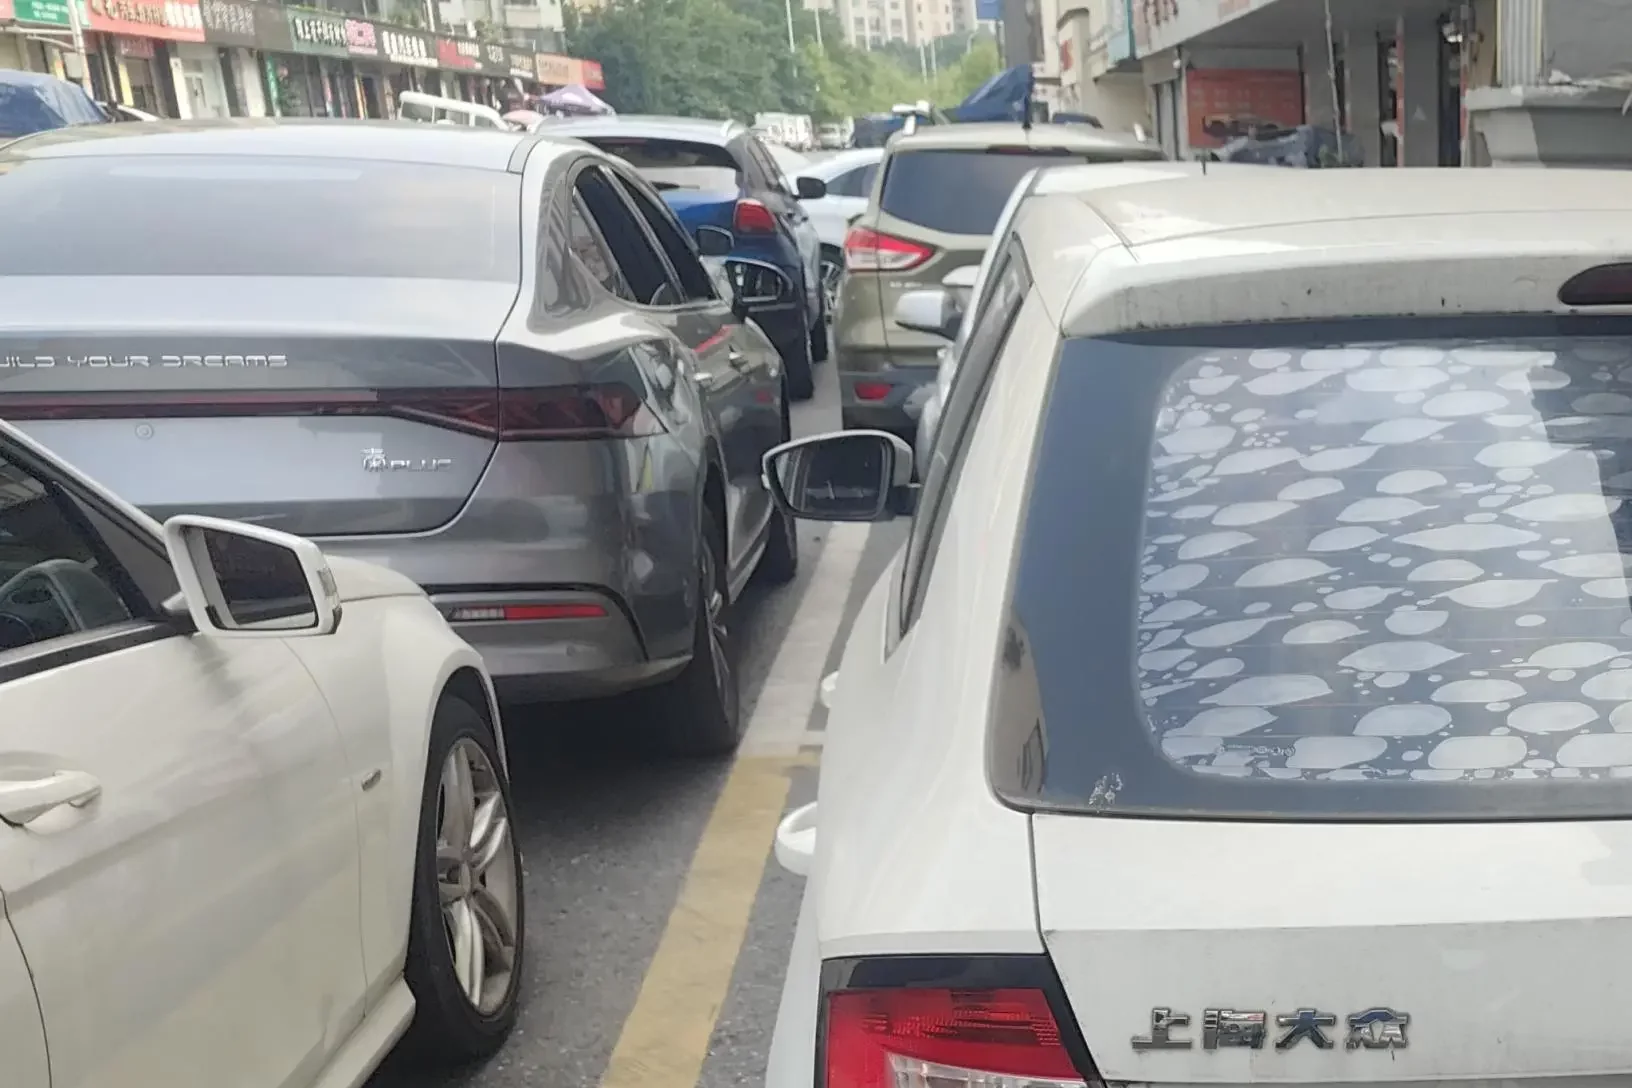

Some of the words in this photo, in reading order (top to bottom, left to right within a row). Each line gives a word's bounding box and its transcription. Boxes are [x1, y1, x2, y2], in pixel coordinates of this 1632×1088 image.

[67, 355, 150, 368] YOUR
[161, 355, 288, 368] DREAMS
[1131, 1007, 1410, 1050] 上海大众
